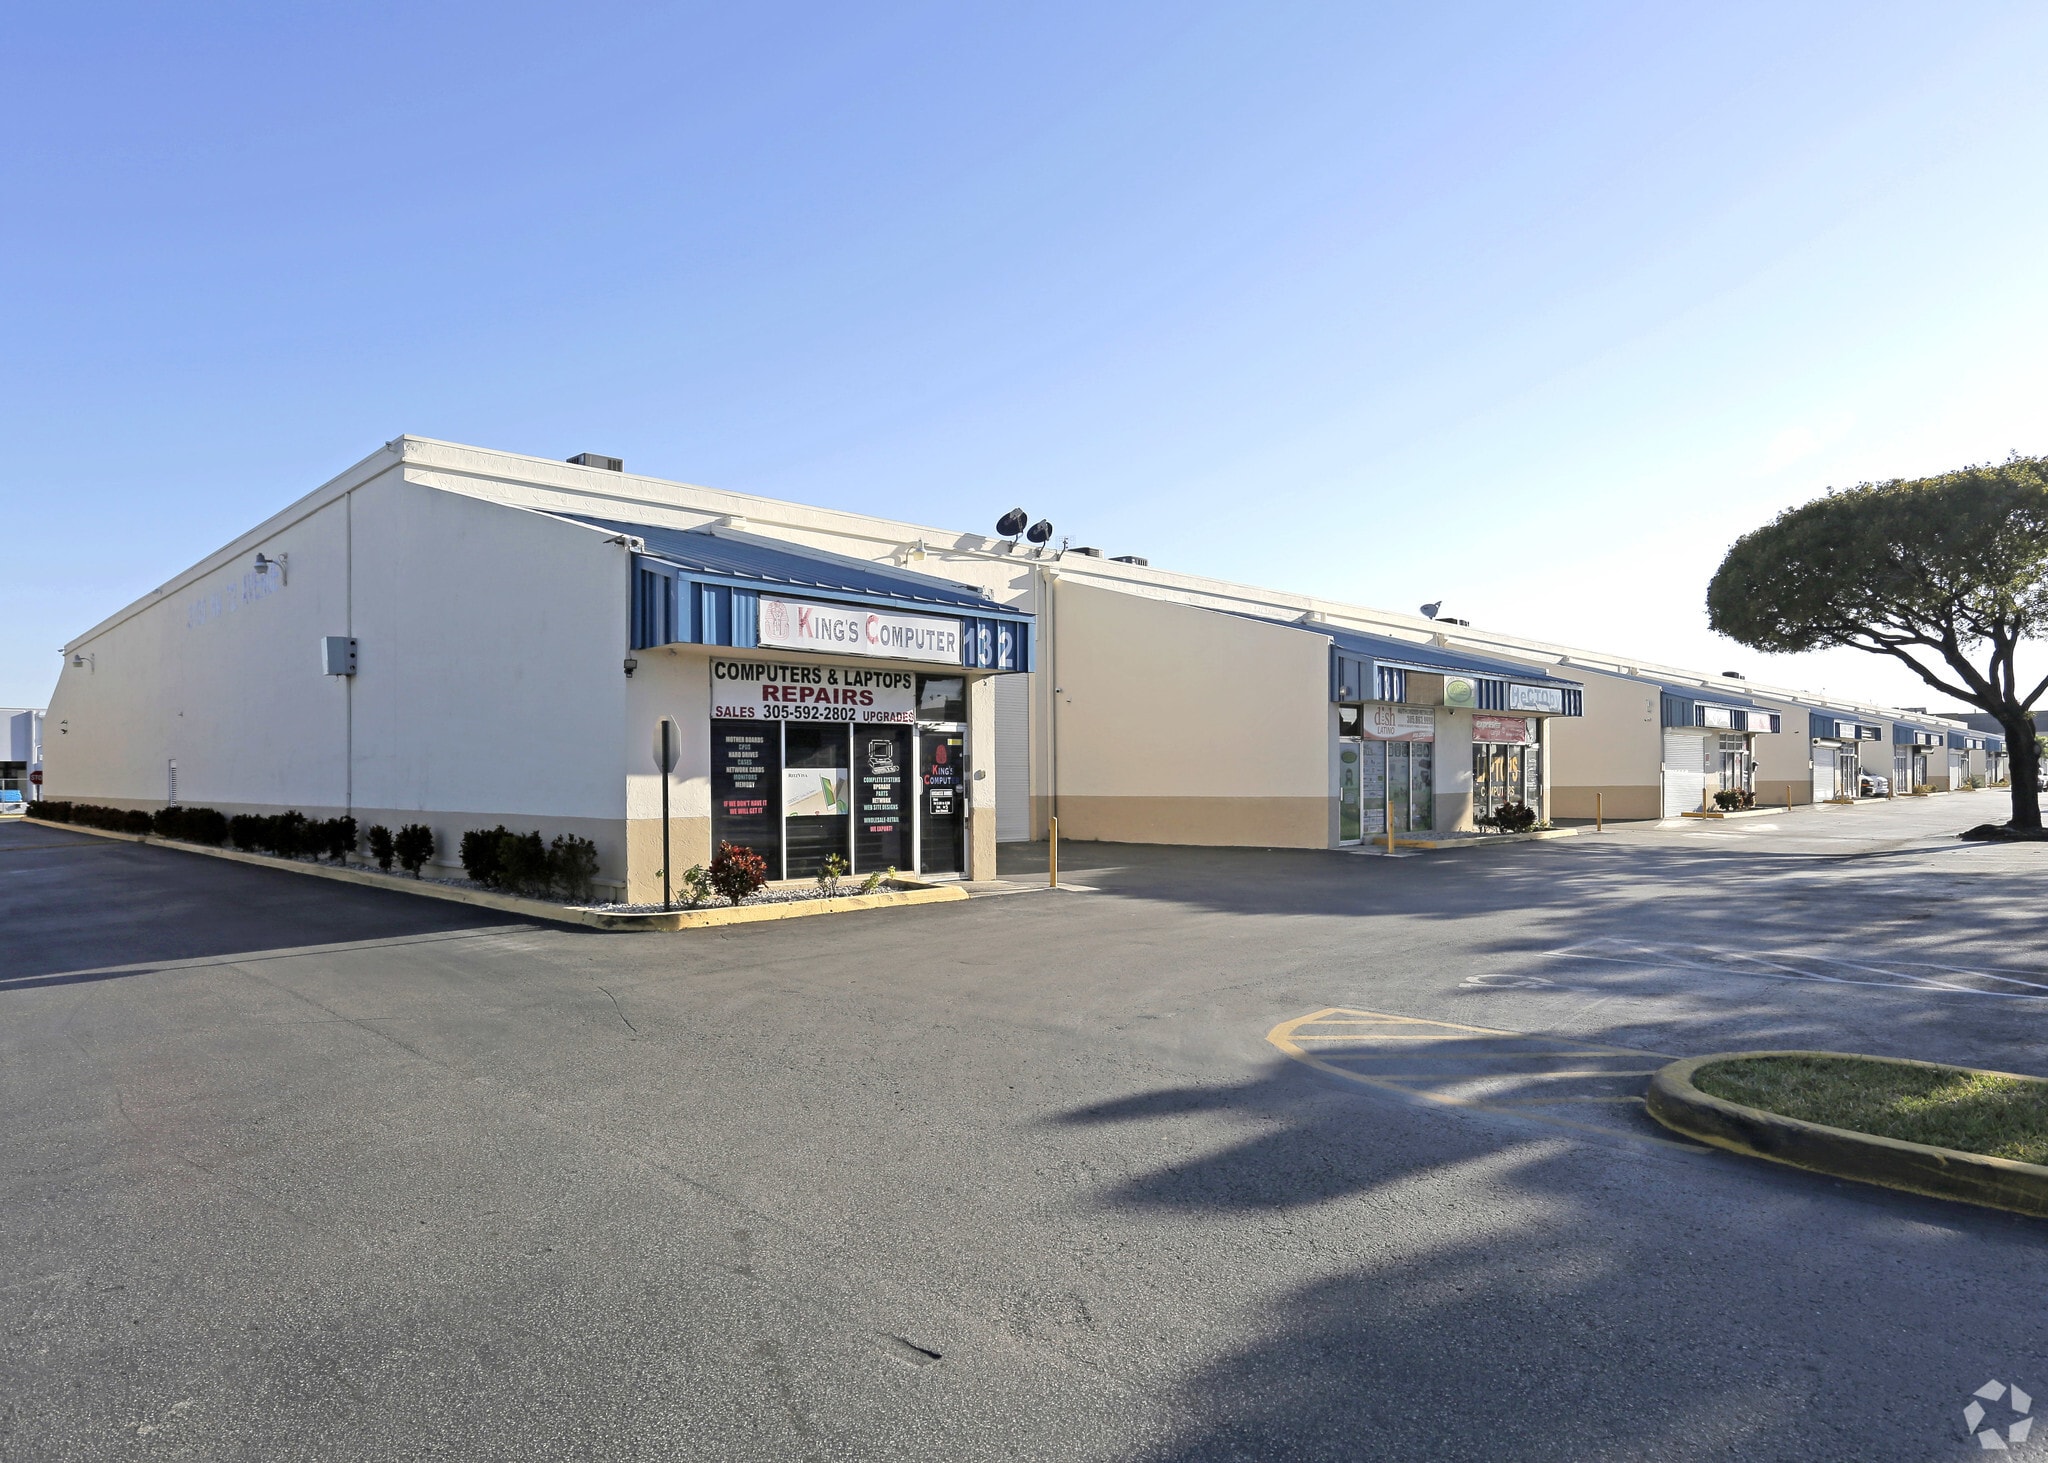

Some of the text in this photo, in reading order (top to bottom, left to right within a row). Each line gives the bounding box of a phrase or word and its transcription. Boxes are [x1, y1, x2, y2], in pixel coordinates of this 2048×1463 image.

[798, 607, 956, 653] KING'S COMPUTER
[964, 627, 1013, 668] 132
[714, 662, 912, 689] COMPUTERS & LAPTOPS
[762, 684, 874, 706] REPAIRS
[716, 704, 915, 723] SALES 305-592-2802 UPGRADES
[1374, 706, 1396, 726] dish
[1378, 726, 1395, 735] LATINO
[932, 764, 953, 775] KING'S
[1480, 786, 1515, 797] CMPUTRS
